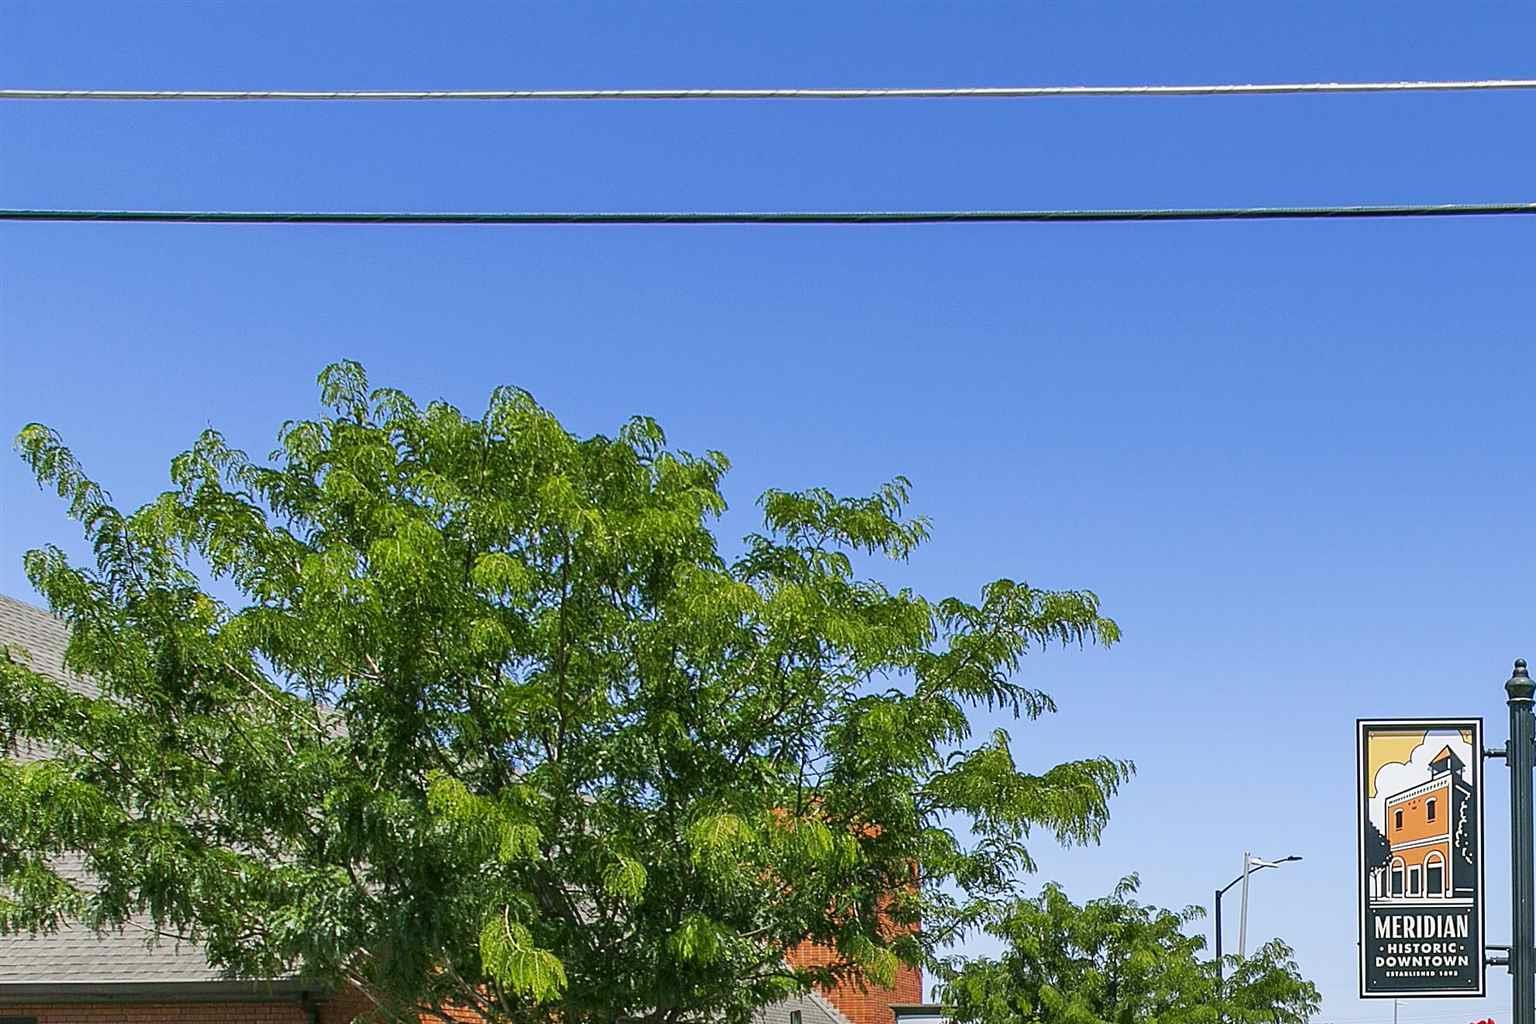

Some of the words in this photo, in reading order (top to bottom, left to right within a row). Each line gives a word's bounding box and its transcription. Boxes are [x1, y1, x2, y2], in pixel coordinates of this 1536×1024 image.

[1375, 915, 1468, 939] MERIDIAN
[1387, 943, 1457, 953] HISTORIC
[1375, 956, 1469, 967] DOWNTOWN
